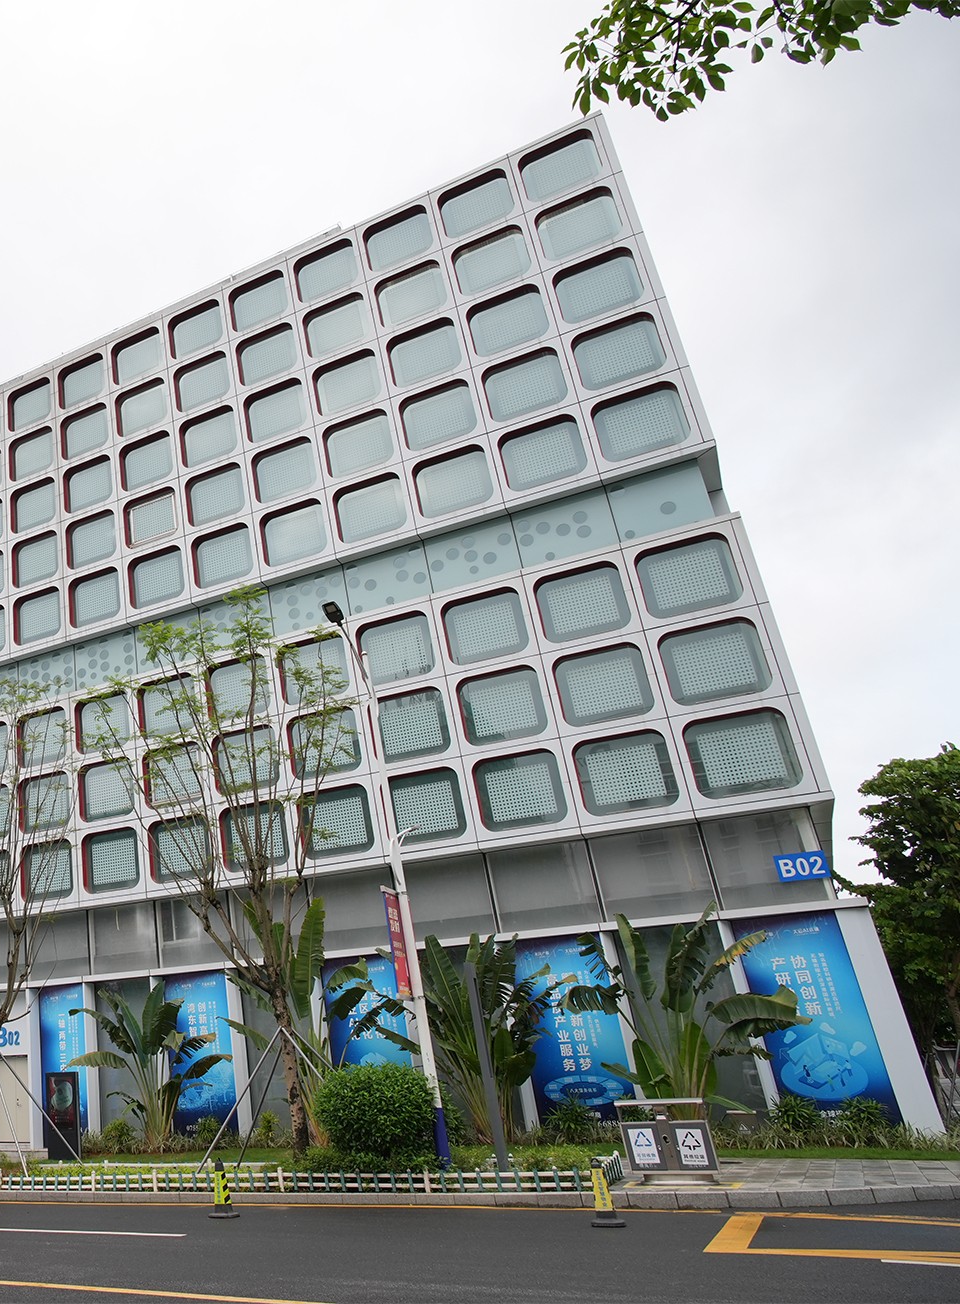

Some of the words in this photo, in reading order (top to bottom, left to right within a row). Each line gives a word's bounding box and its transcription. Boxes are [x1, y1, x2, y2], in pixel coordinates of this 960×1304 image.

[778, 855, 827, 880] B02
[790, 954, 822, 1016] 协同创新
